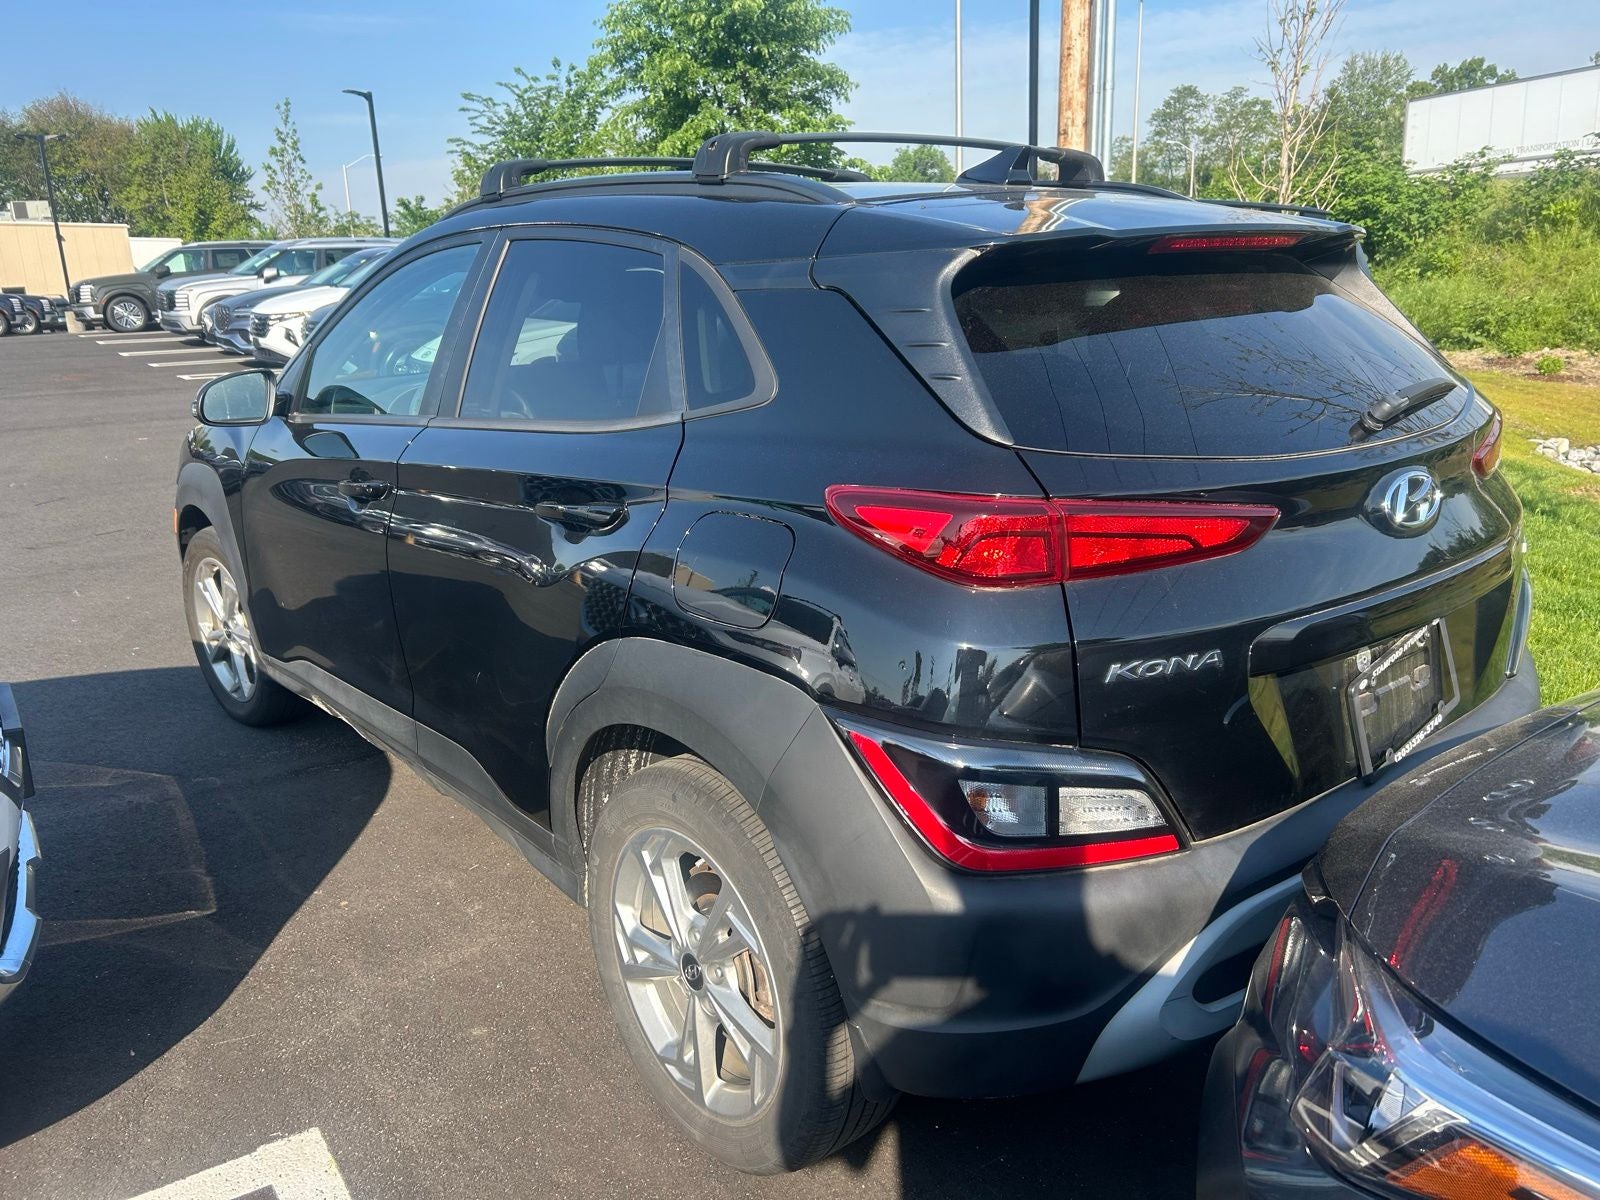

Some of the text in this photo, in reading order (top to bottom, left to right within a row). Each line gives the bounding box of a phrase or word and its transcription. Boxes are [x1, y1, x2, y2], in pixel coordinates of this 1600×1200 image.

[1516, 139, 1580, 153] TRANSPORTATION
[1105, 649, 1223, 683] KONA
[1373, 647, 1403, 677] STAMFORD
